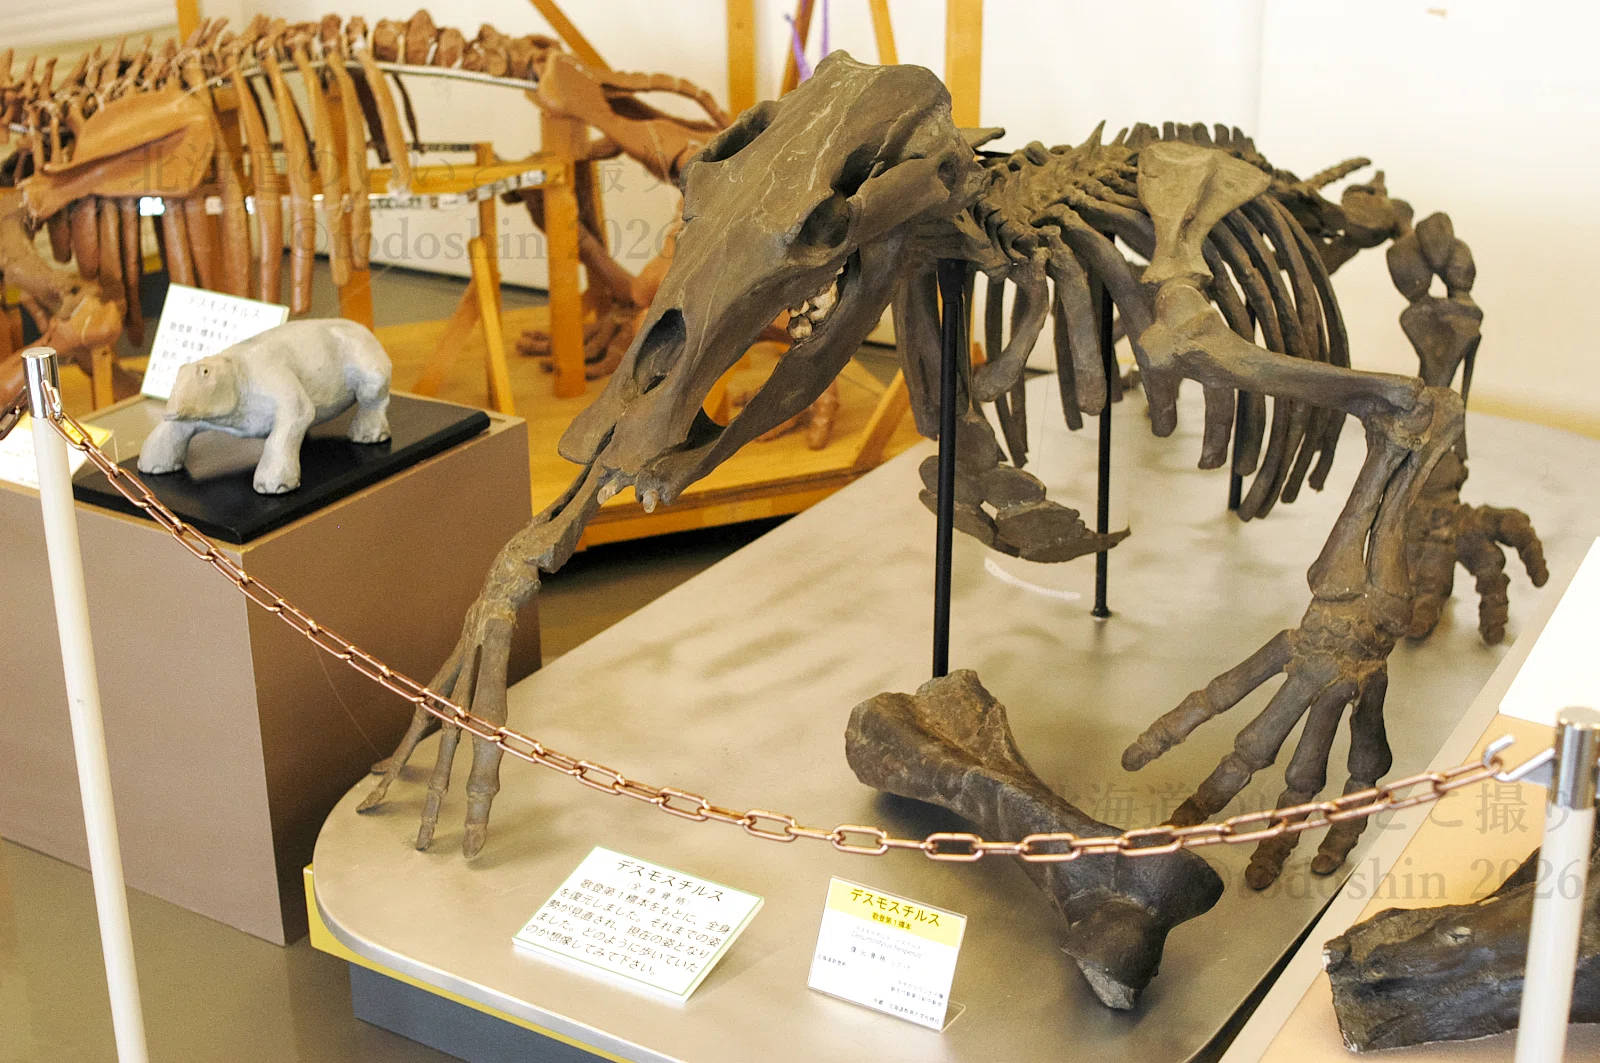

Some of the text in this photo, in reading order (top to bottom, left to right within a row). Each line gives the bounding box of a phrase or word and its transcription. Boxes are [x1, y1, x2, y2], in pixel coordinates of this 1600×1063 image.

[617, 859, 724, 902] デスモスチルス
[850, 888, 940, 927] デスモスチルス
